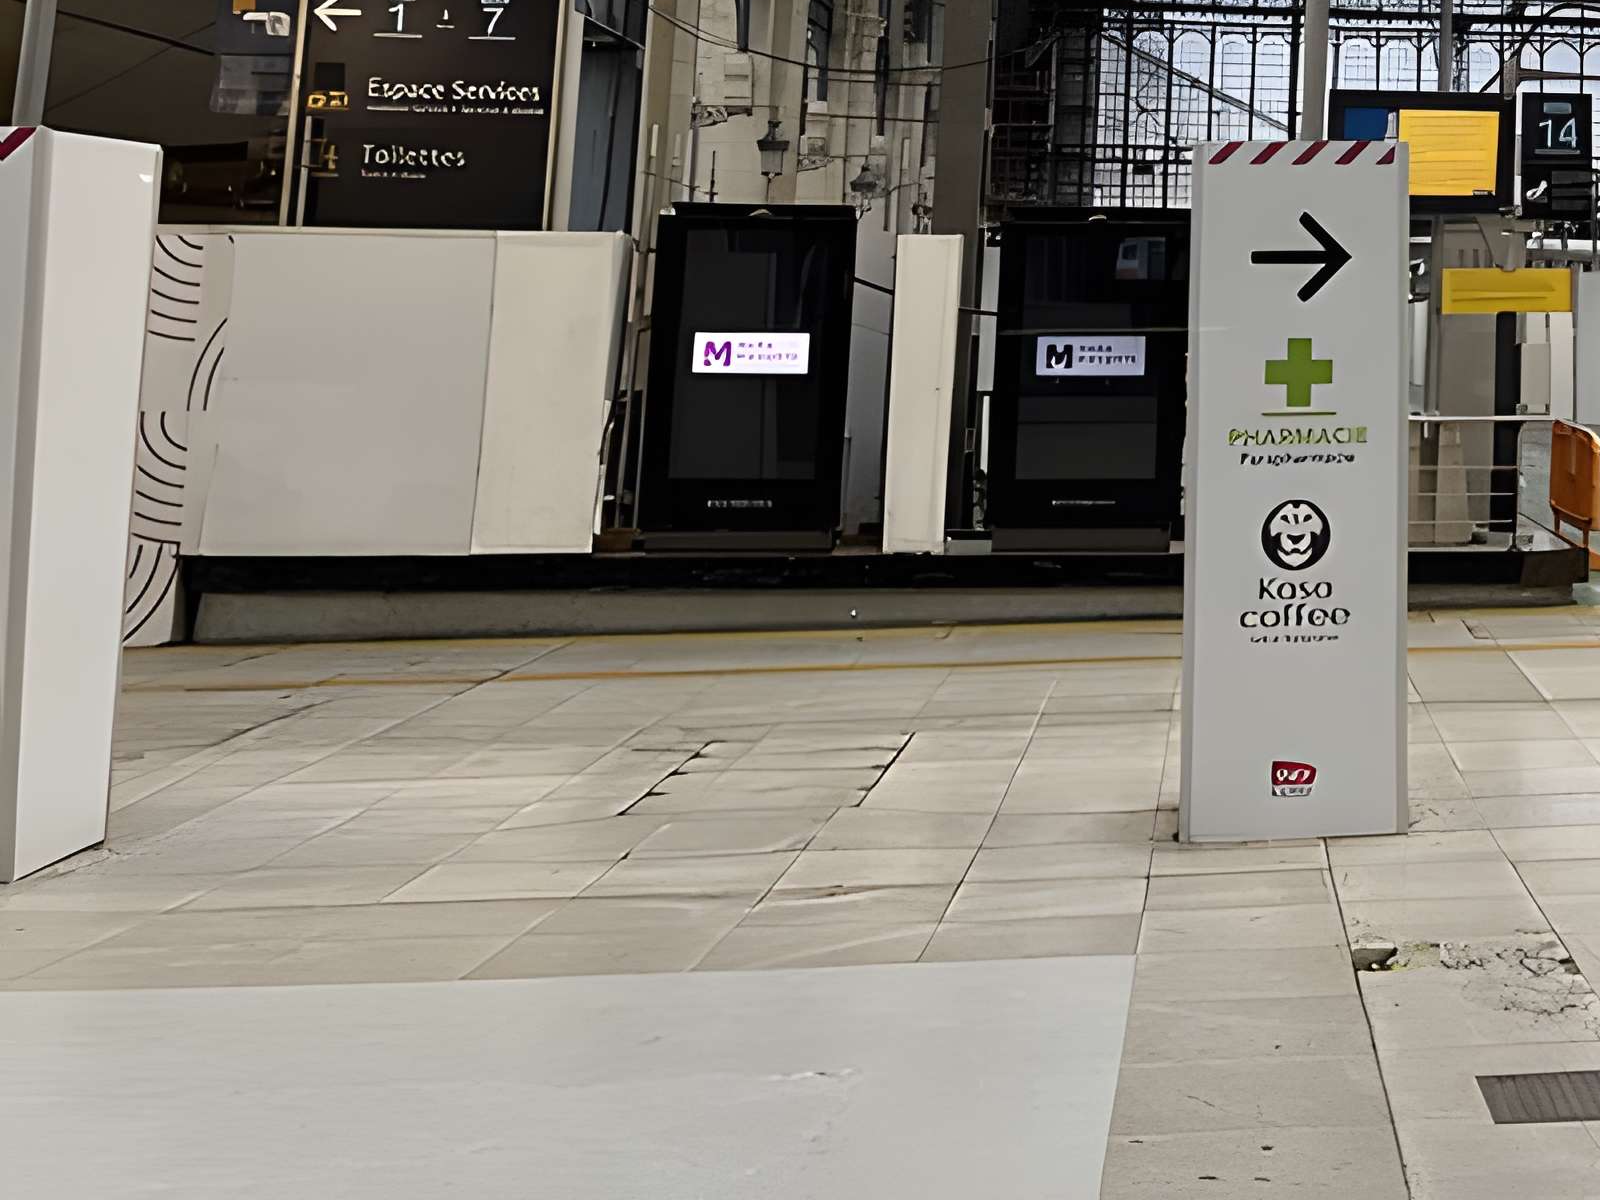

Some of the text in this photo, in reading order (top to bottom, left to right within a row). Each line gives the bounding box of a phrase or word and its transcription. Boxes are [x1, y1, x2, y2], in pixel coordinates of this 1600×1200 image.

[388, 3, 404, 32] 1
[482, 7, 505, 38] 7
[1538, 117, 1578, 149] 14
